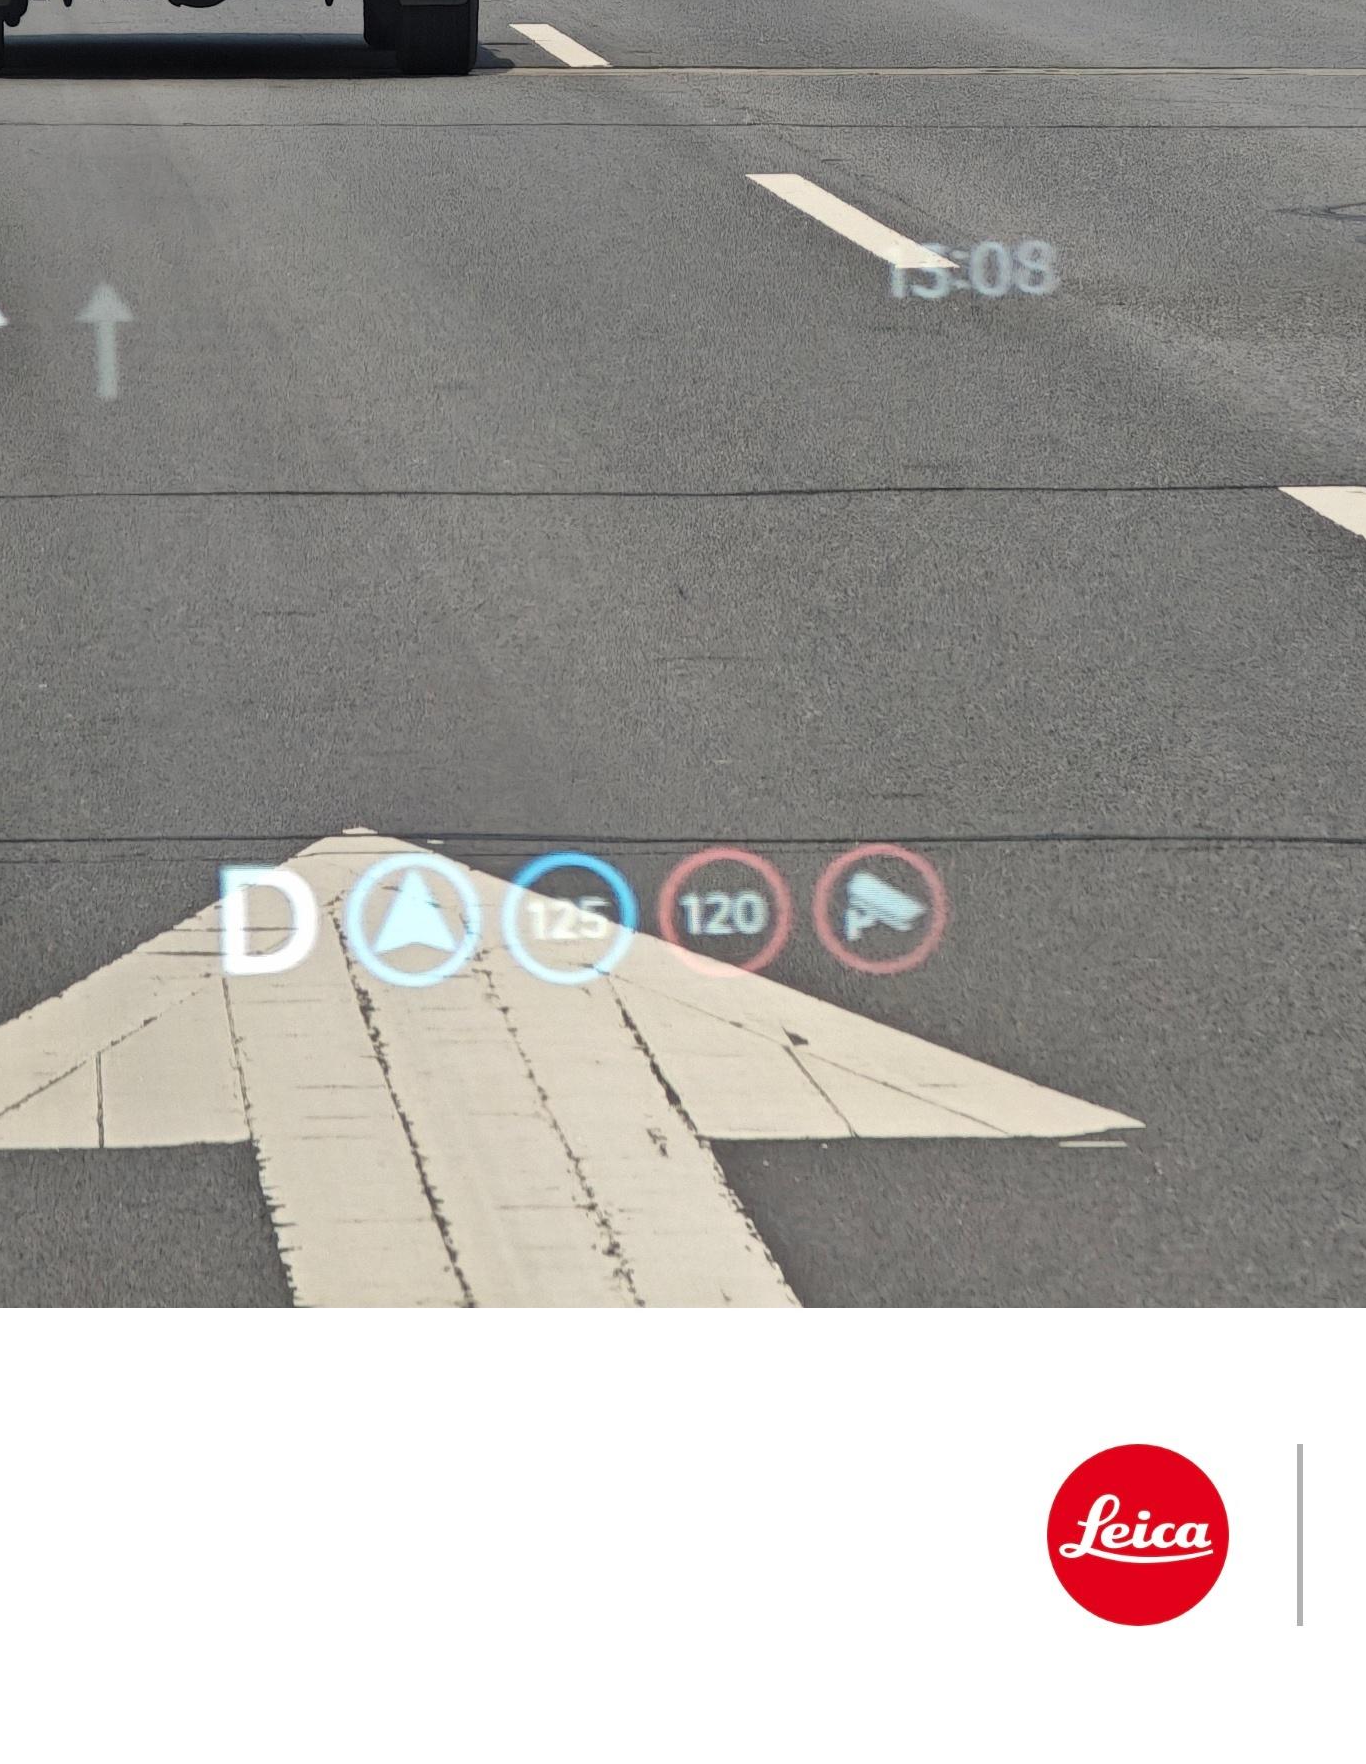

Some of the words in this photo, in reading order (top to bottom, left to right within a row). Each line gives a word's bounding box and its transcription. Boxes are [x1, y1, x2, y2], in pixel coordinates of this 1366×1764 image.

[220, 864, 316, 976] D
[525, 897, 610, 942] 125
[680, 890, 769, 937] 120
